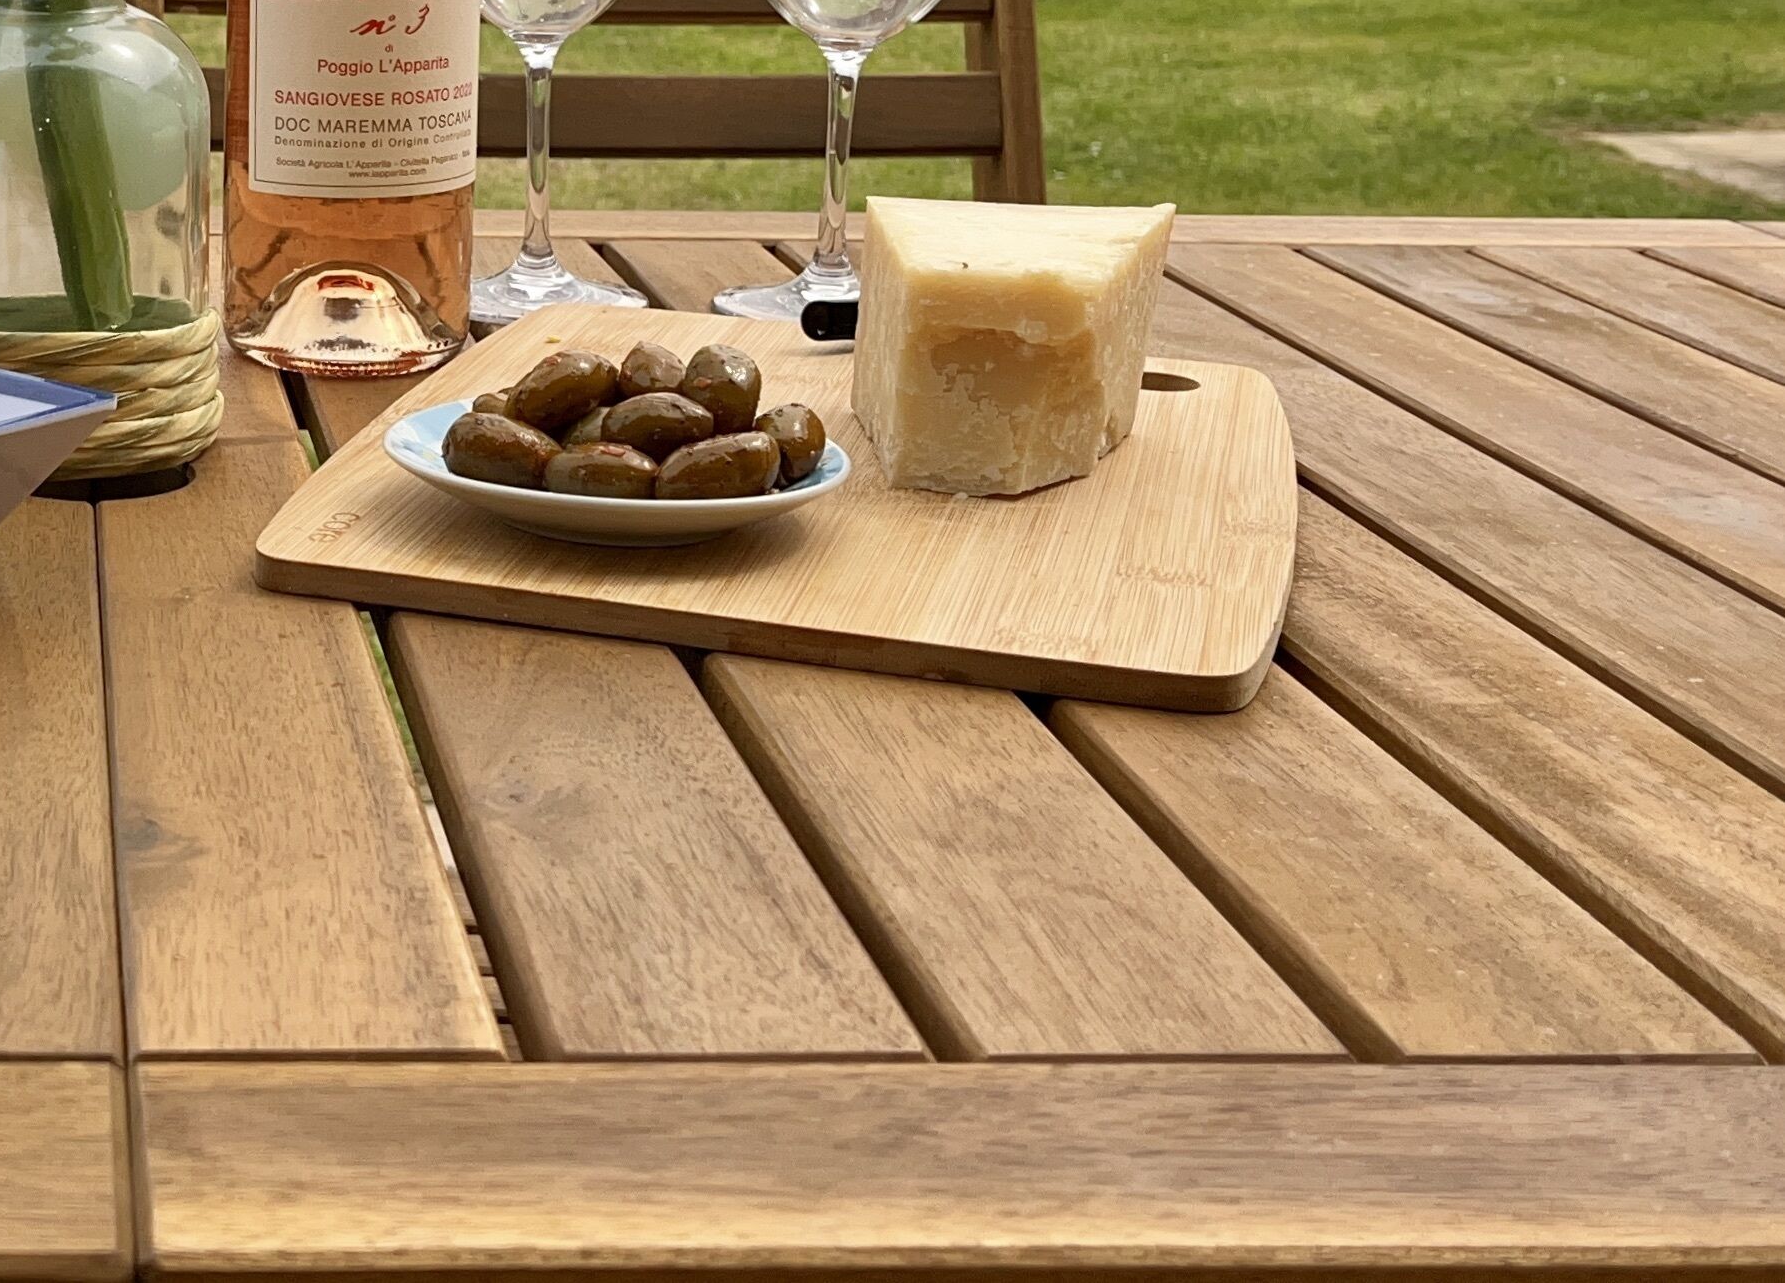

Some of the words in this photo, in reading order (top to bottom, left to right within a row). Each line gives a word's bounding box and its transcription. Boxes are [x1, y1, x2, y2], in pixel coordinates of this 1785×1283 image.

[405, 4, 430, 35] 3
[384, 43, 394, 53] di
[317, 59, 374, 76] Poggio
[379, 56, 450, 75] L'Apparita
[275, 89, 385, 107] SANGIOVESE
[391, 87, 450, 106] ROSATO
[275, 116, 311, 132] DOC
[317, 118, 413, 134] MAREMMA
[418, 108, 472, 130] TOSCANA
[274, 135, 366, 149] Denominazione
[371, 137, 383, 149] di
[388, 136, 429, 149] Origine
